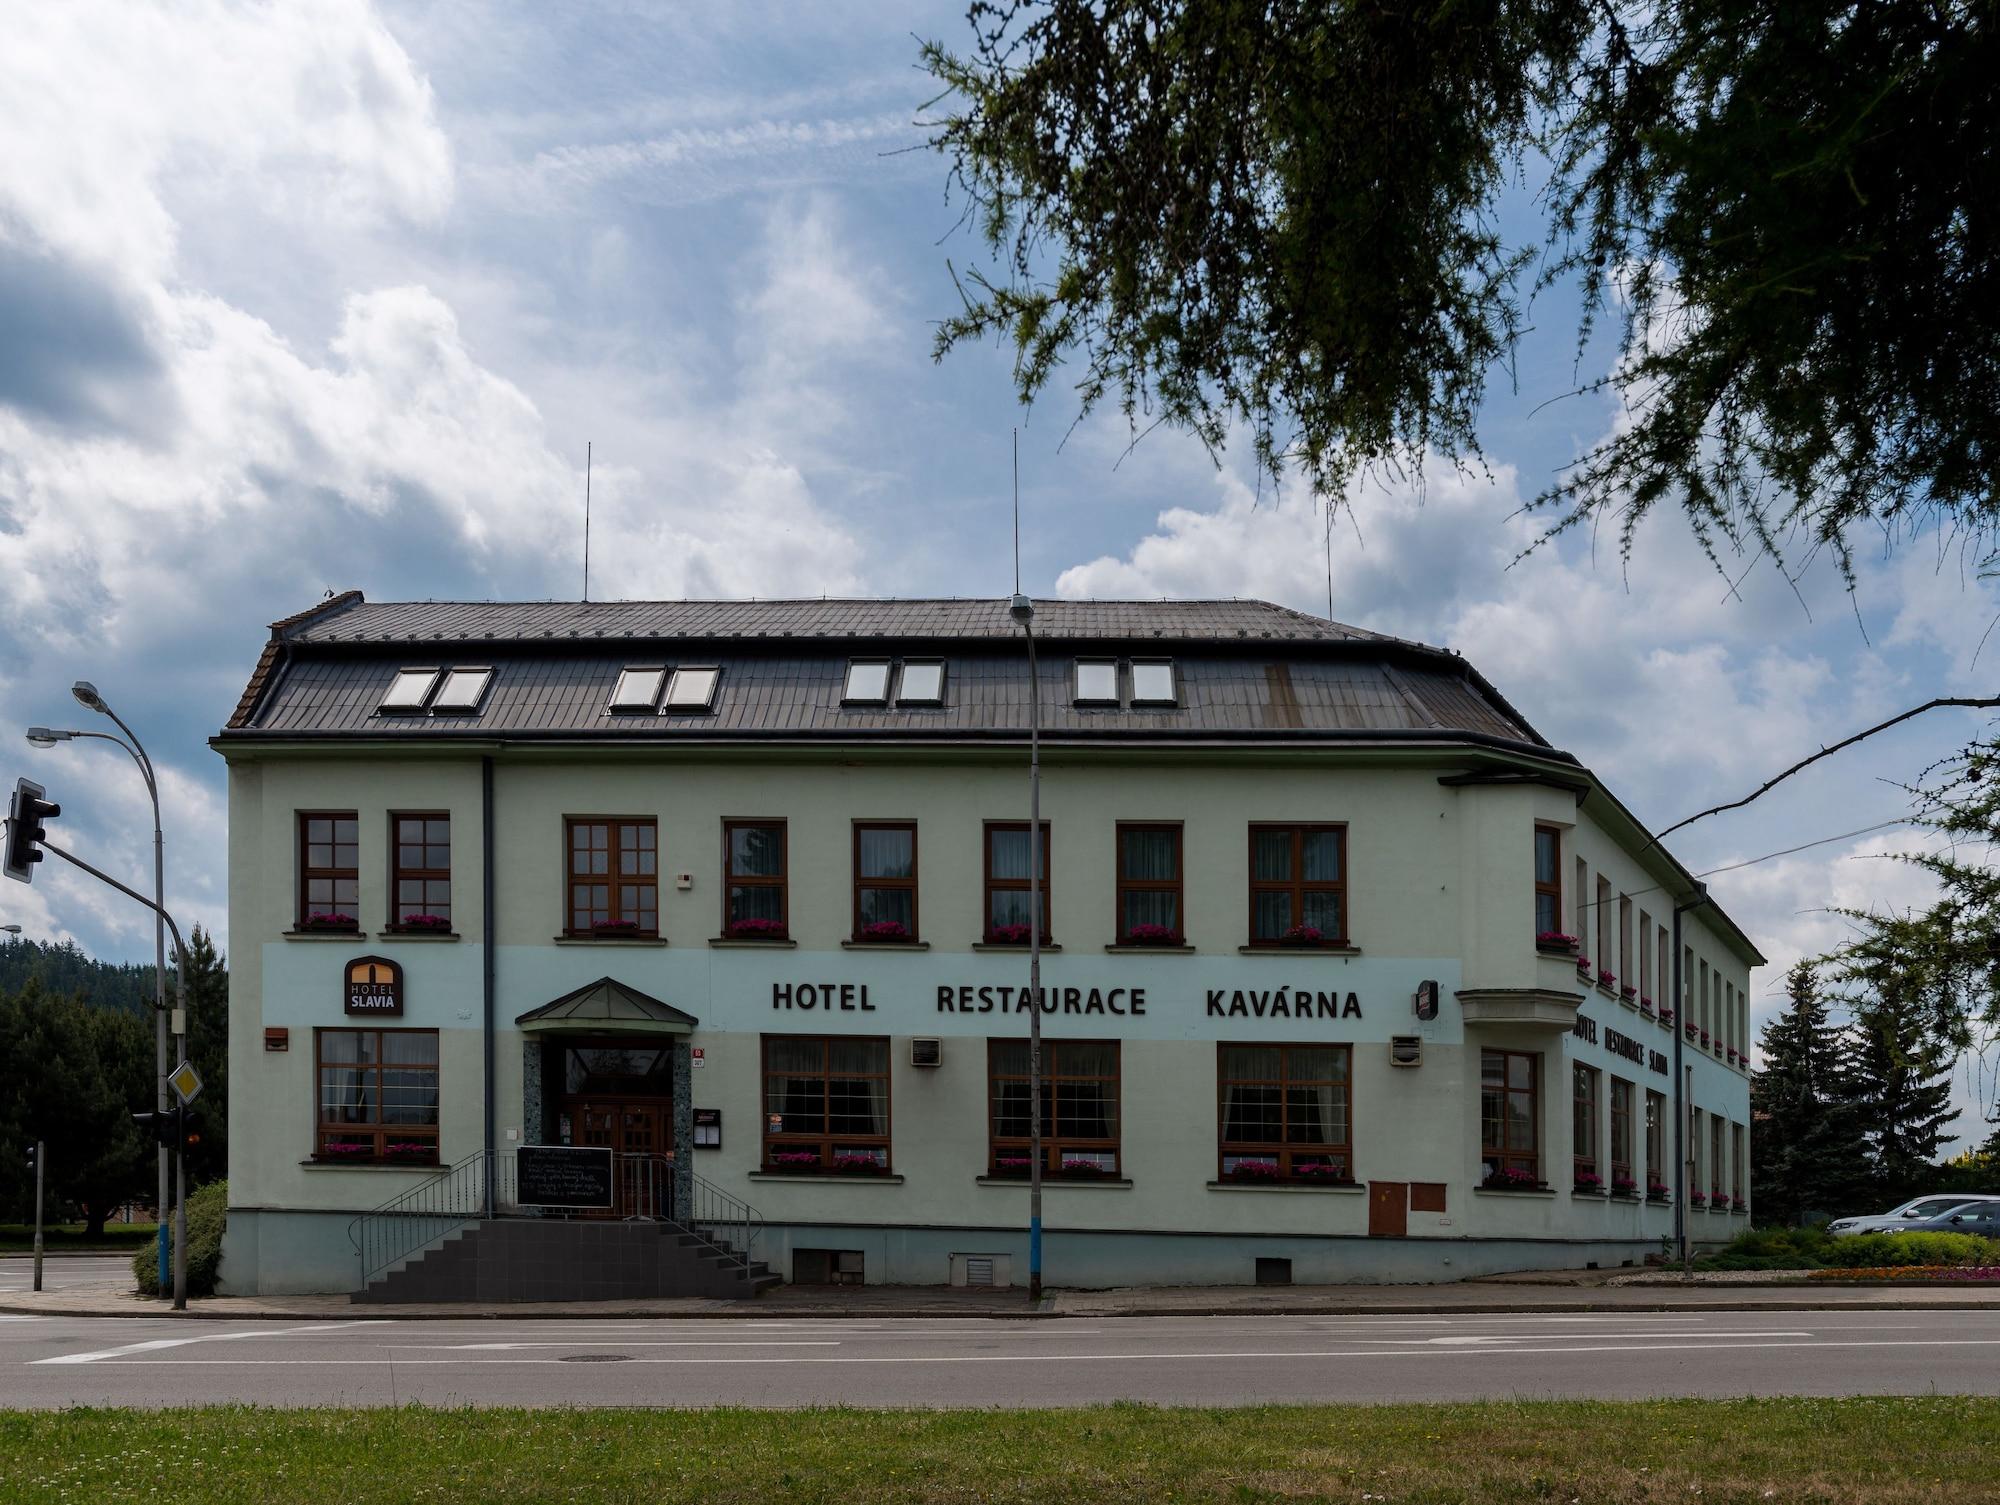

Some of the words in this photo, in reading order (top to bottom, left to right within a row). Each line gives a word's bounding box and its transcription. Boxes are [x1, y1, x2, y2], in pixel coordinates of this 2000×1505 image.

[351, 985, 394, 994] HOTEL
[351, 995, 395, 1008] SLAVIA
[773, 984, 877, 1011] HOTEL
[938, 986, 1146, 1016] RESTAURACE
[1207, 986, 1363, 1019] KAVÁRNA
[1573, 1013, 1598, 1044] HOTEL
[1605, 1027, 1645, 1066] RESTAURACE
[1649, 1049, 1669, 1076] SLAVIA
